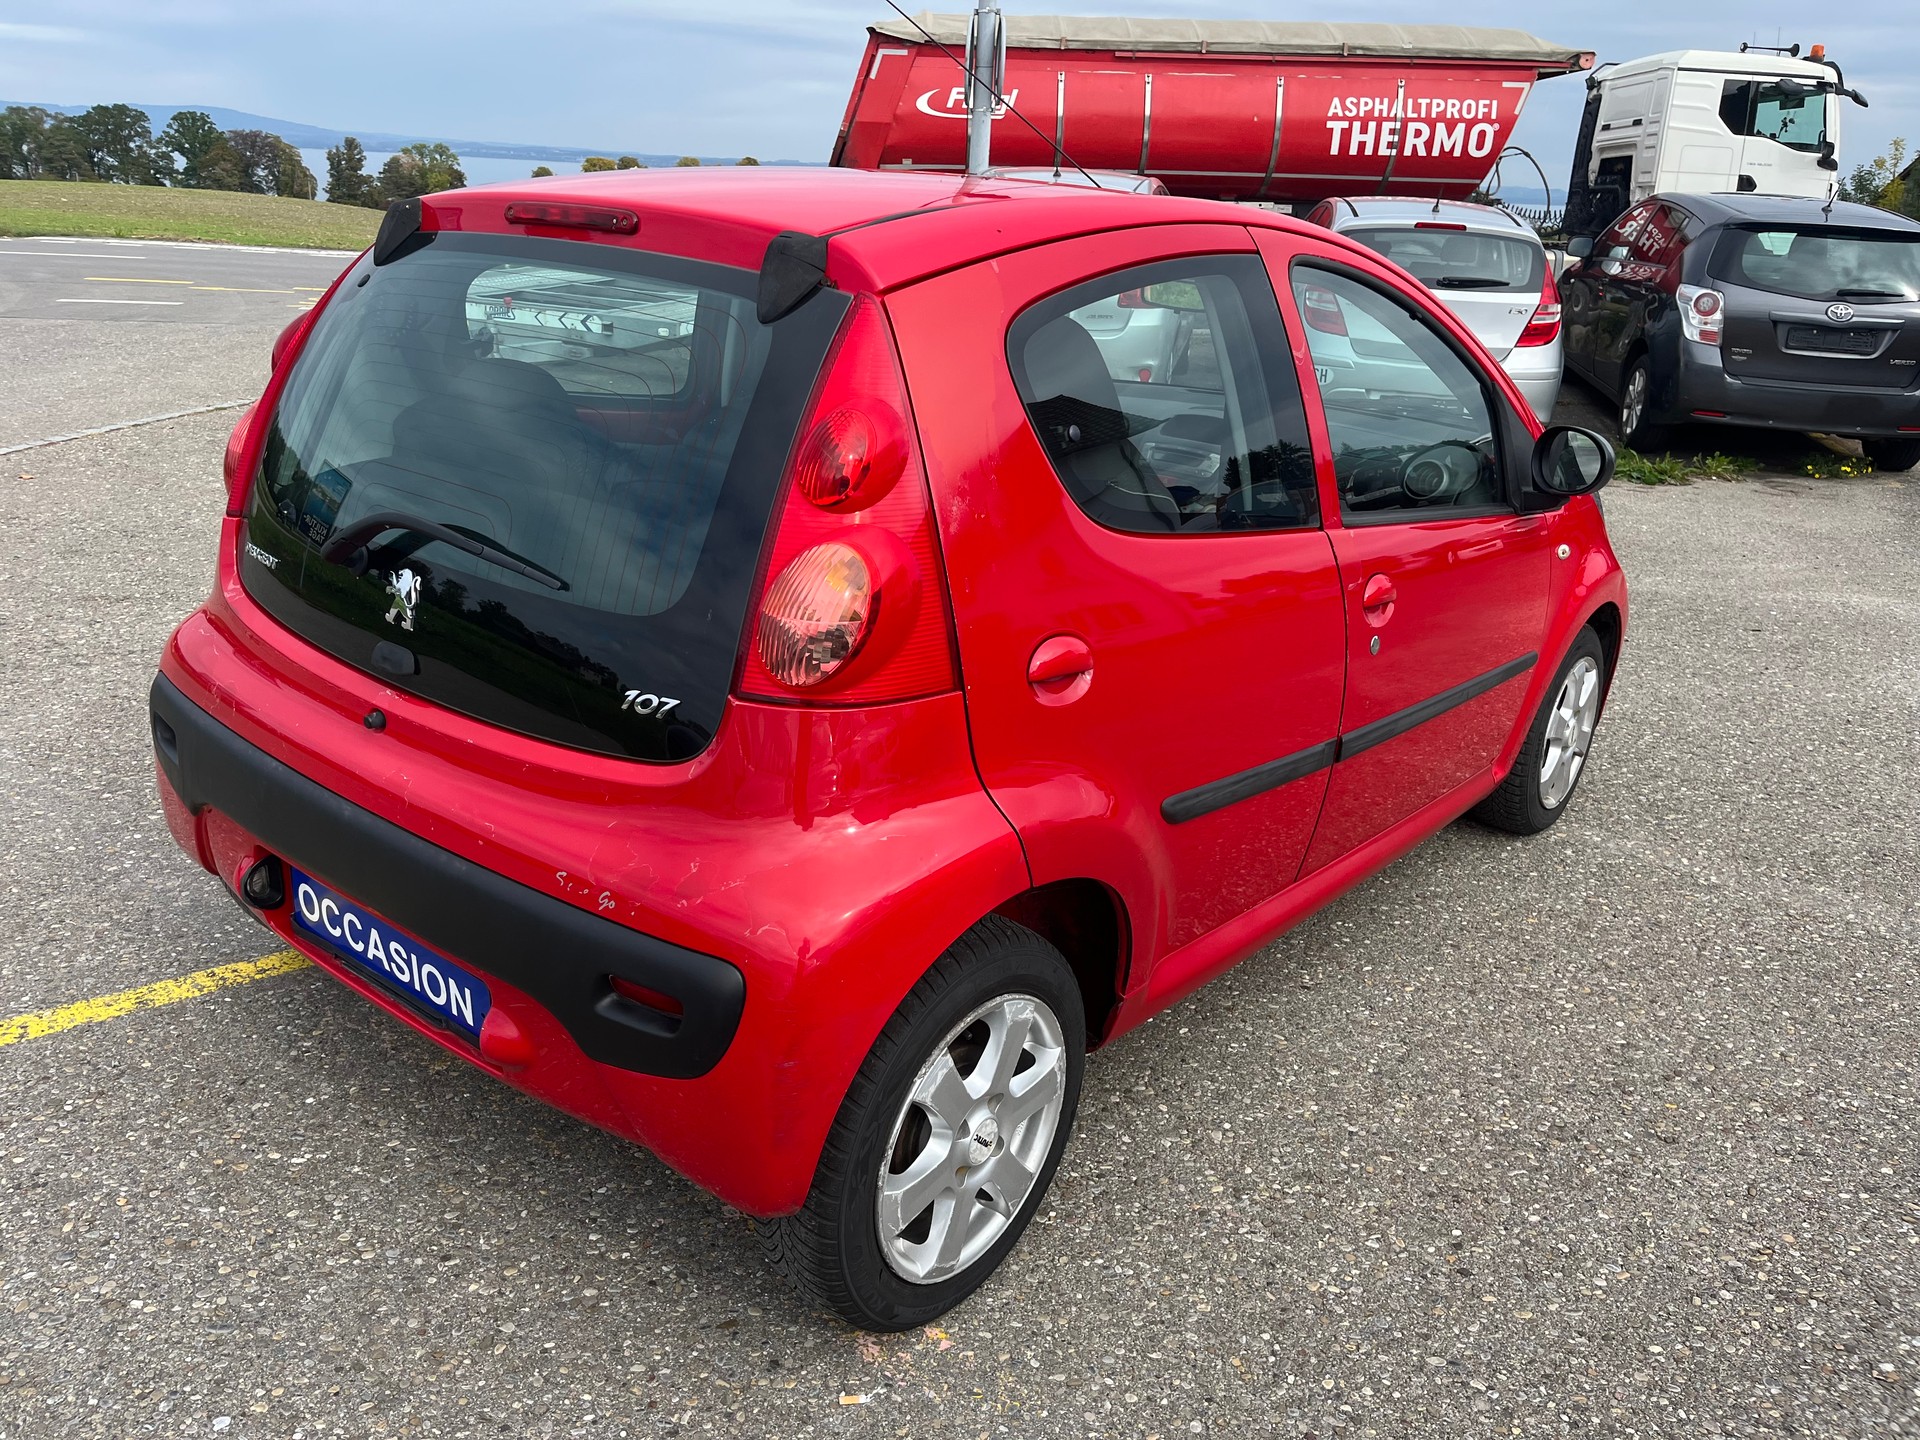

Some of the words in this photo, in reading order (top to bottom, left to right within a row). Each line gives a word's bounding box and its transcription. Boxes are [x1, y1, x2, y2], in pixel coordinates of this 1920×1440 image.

[1327, 97, 1498, 119] ASPHALTPROFI
[621, 689, 681, 719] 107
[298, 883, 474, 1026] OCCASION
